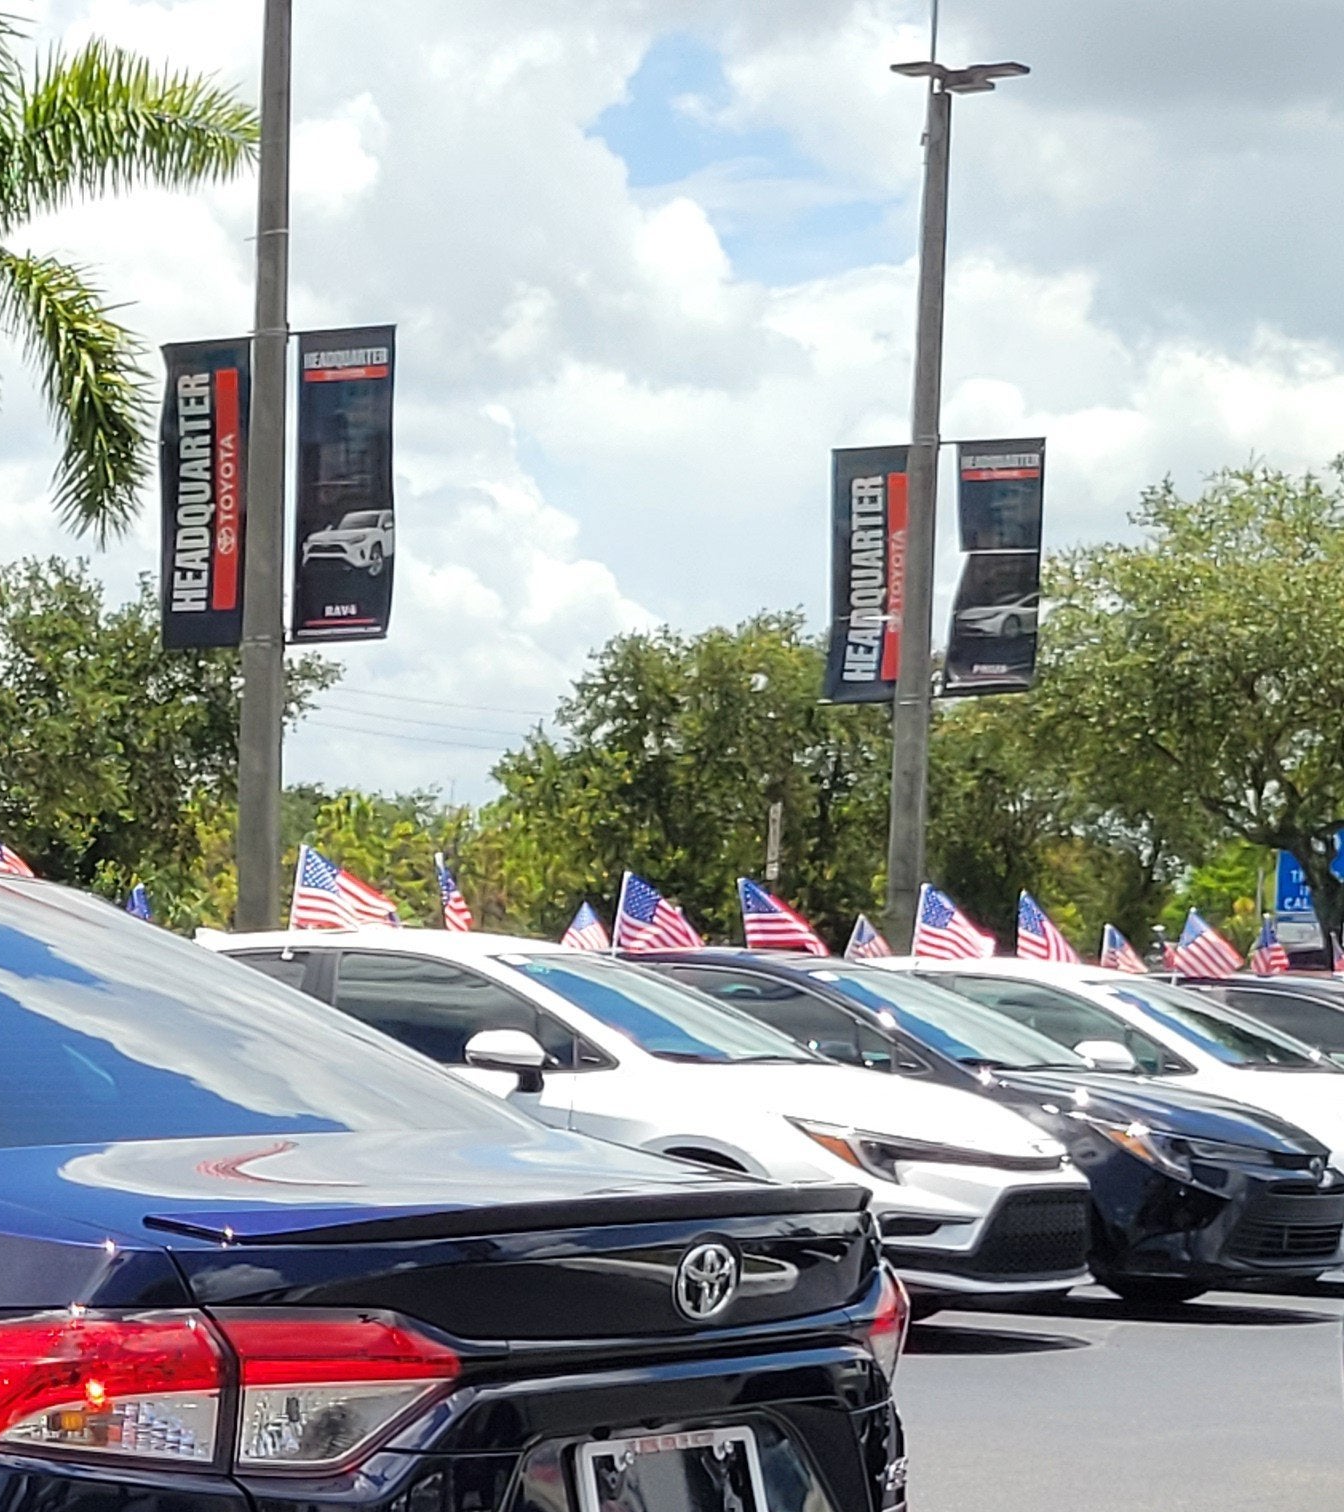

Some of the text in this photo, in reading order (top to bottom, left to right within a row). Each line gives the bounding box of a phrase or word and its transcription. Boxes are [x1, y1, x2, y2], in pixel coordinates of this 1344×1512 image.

[172, 373, 216, 612] HEADQUARTER
[220, 433, 236, 523] TOYOTA
[842, 475, 887, 681] HEADQUARTER
